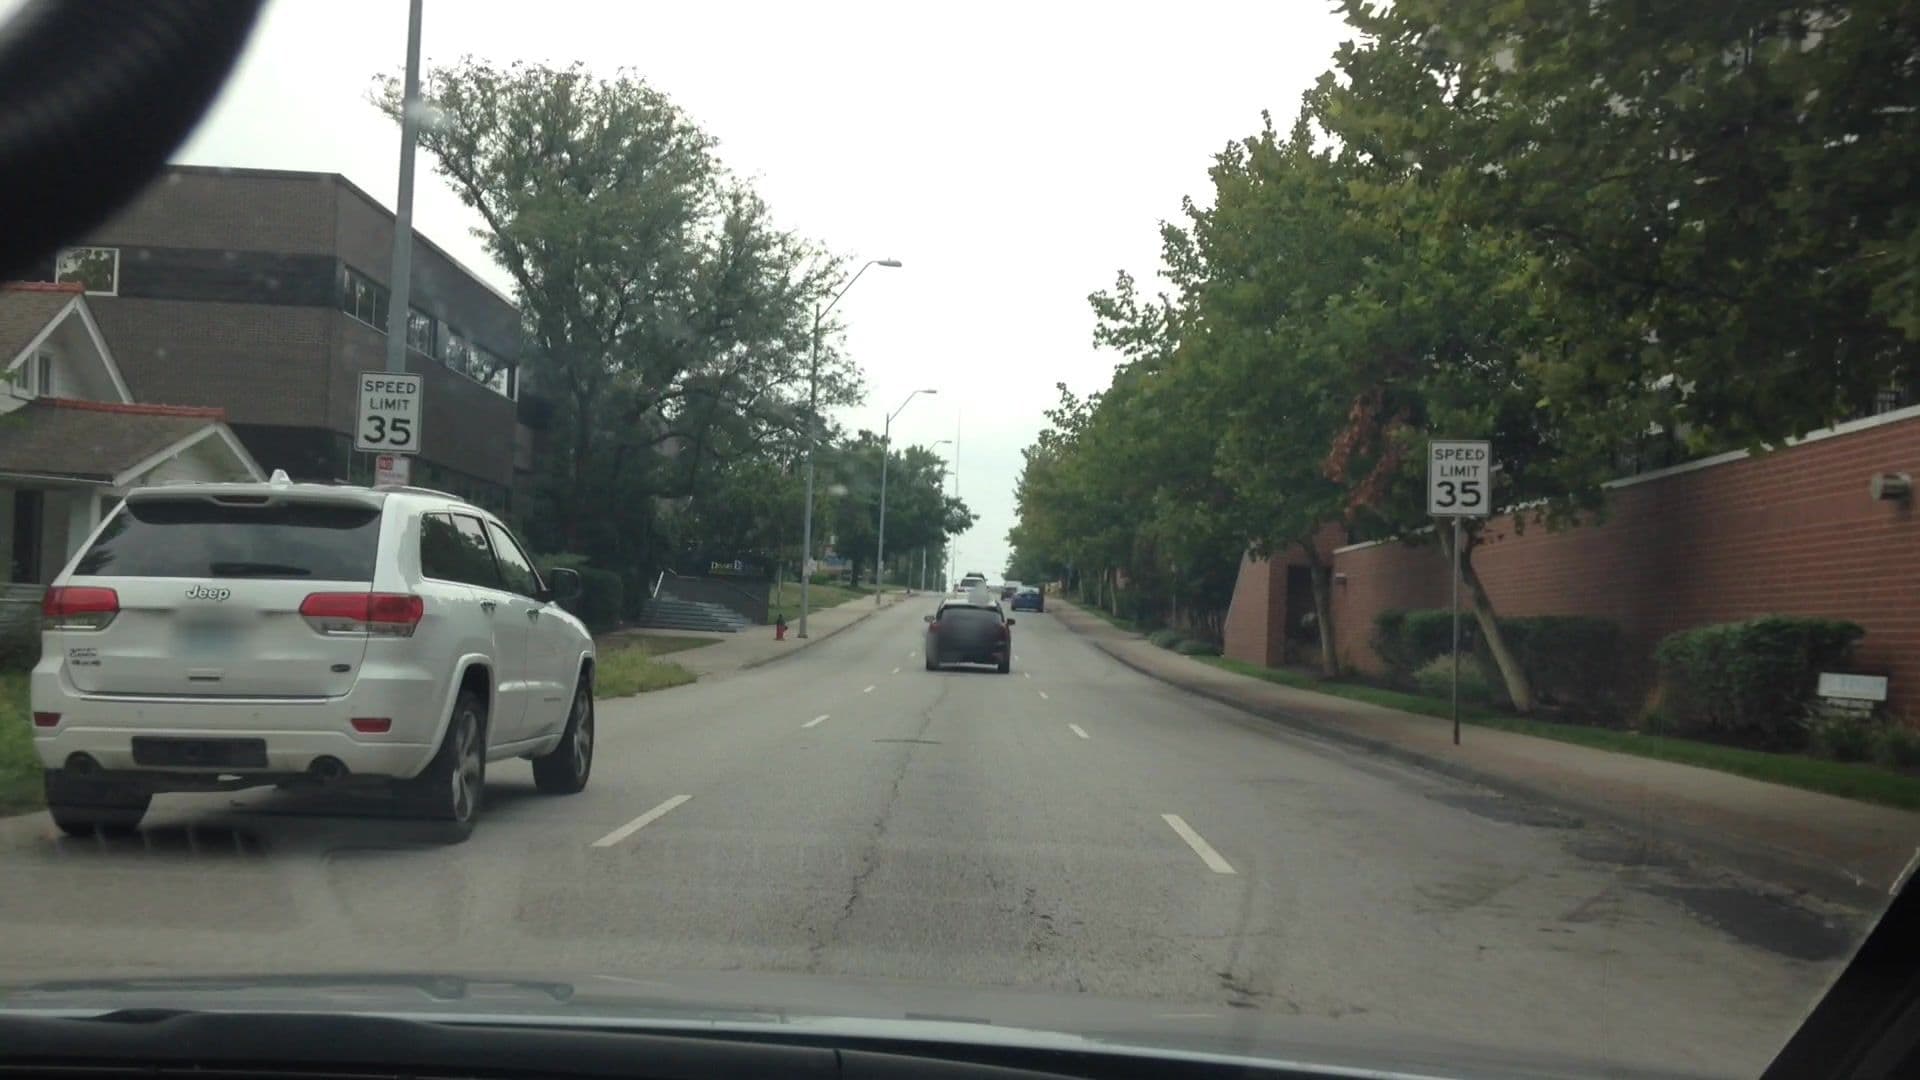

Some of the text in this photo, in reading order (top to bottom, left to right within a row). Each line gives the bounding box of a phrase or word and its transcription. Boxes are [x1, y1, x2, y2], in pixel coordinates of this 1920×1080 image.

[364, 380, 416, 394] SPEED
[369, 398, 410, 411] LIMIT
[363, 415, 411, 445] 35
[1434, 448, 1485, 460] SPEED
[1440, 465, 1480, 477] LIMIT
[1436, 481, 1481, 507] 35
[186, 584, 231, 602] Jeep
